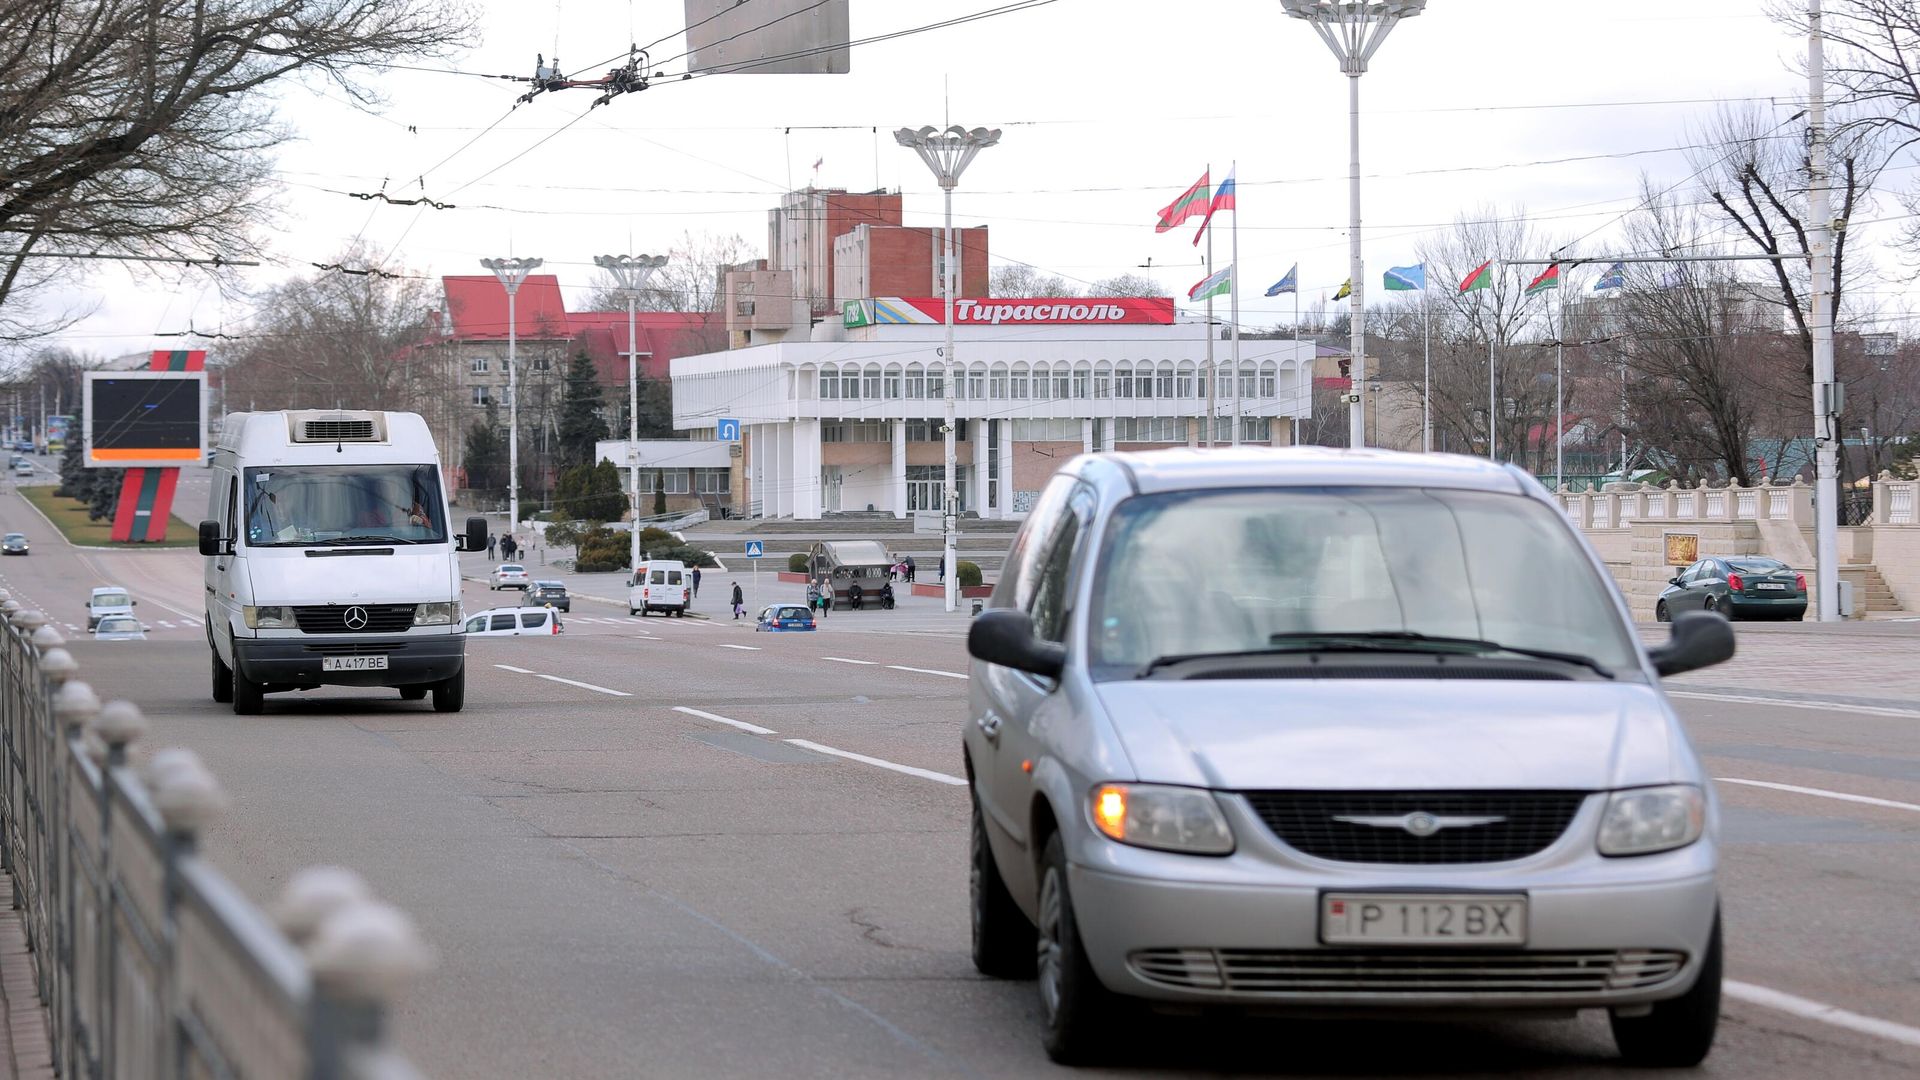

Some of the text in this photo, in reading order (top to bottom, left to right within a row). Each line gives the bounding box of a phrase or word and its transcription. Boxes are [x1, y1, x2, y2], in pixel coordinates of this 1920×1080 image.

[956, 300, 1125, 324] Тирасполь
[1360, 904, 1512, 935] P 112 BX
